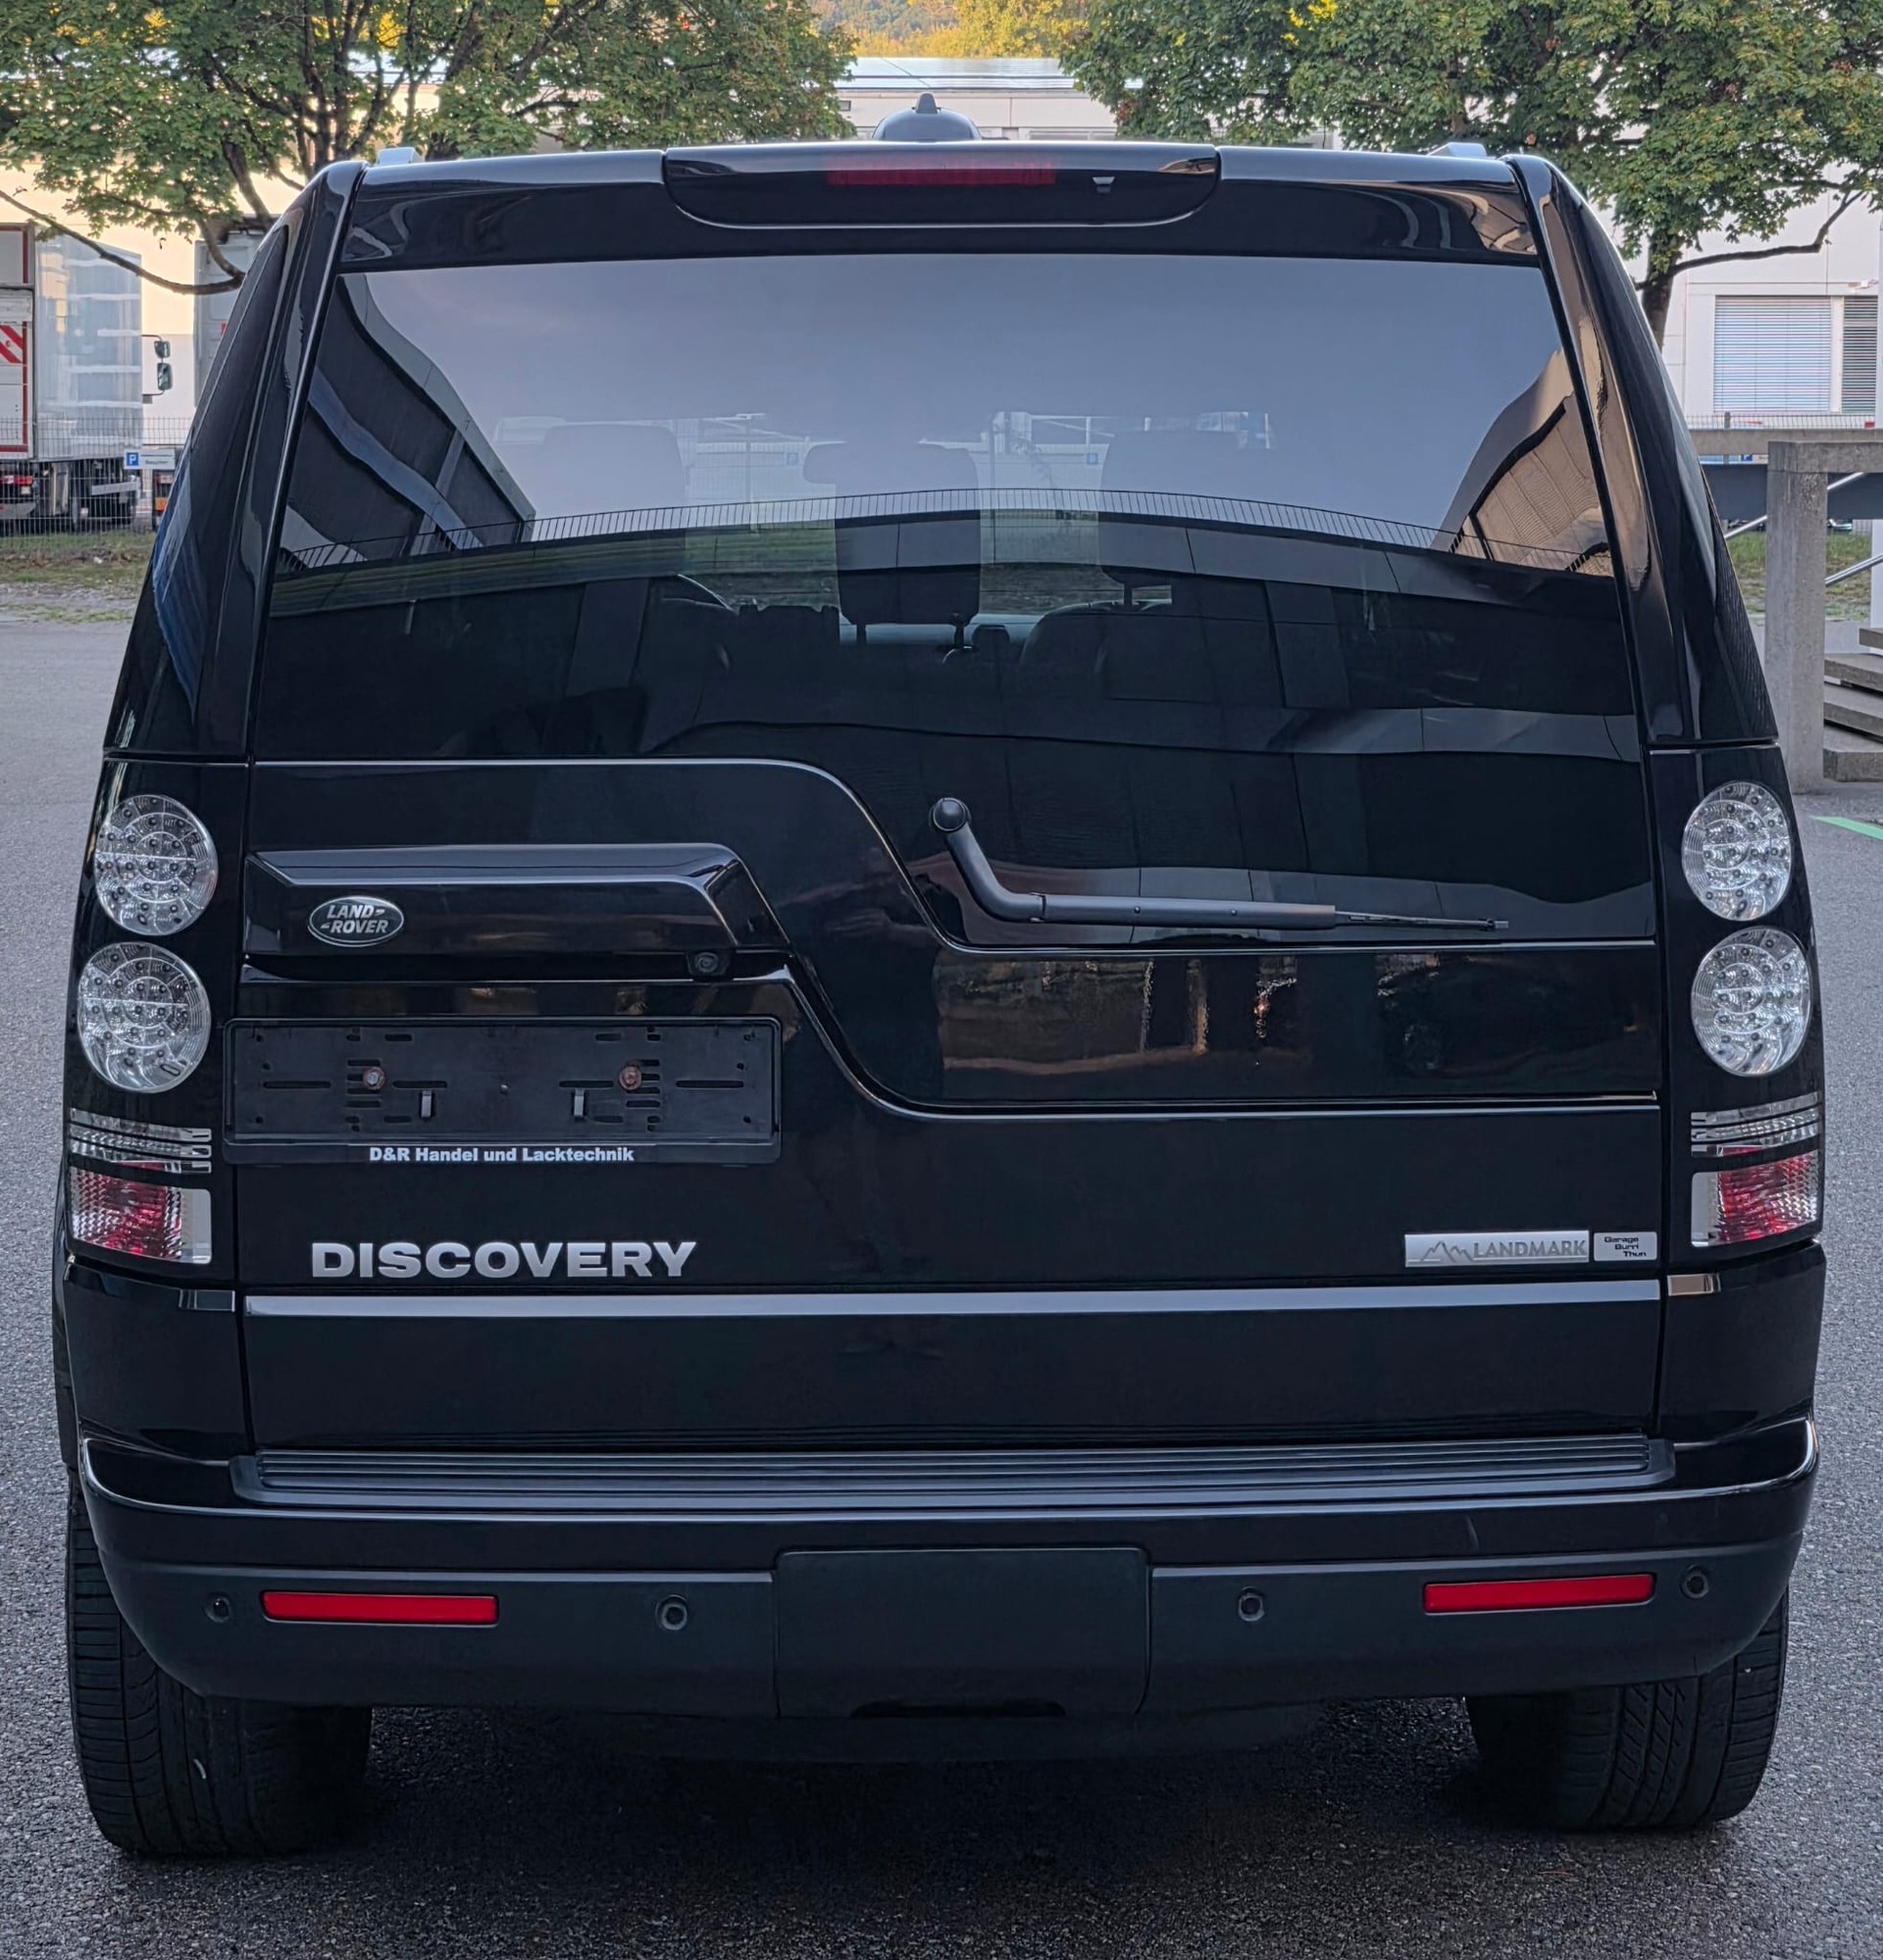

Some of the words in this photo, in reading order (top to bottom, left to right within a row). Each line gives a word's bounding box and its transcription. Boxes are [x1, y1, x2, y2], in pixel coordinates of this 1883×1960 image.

[128, 454, 137, 465] P
[327, 904, 374, 919] LAND
[330, 920, 389, 933] ROVER
[369, 1147, 410, 1162] D&R
[415, 1147, 479, 1162] Handel
[483, 1147, 517, 1162] und
[522, 1146, 636, 1162] Lacktechnik
[1473, 1239, 1586, 1259] LANDMARK
[311, 1241, 697, 1279] DISCOVERY
